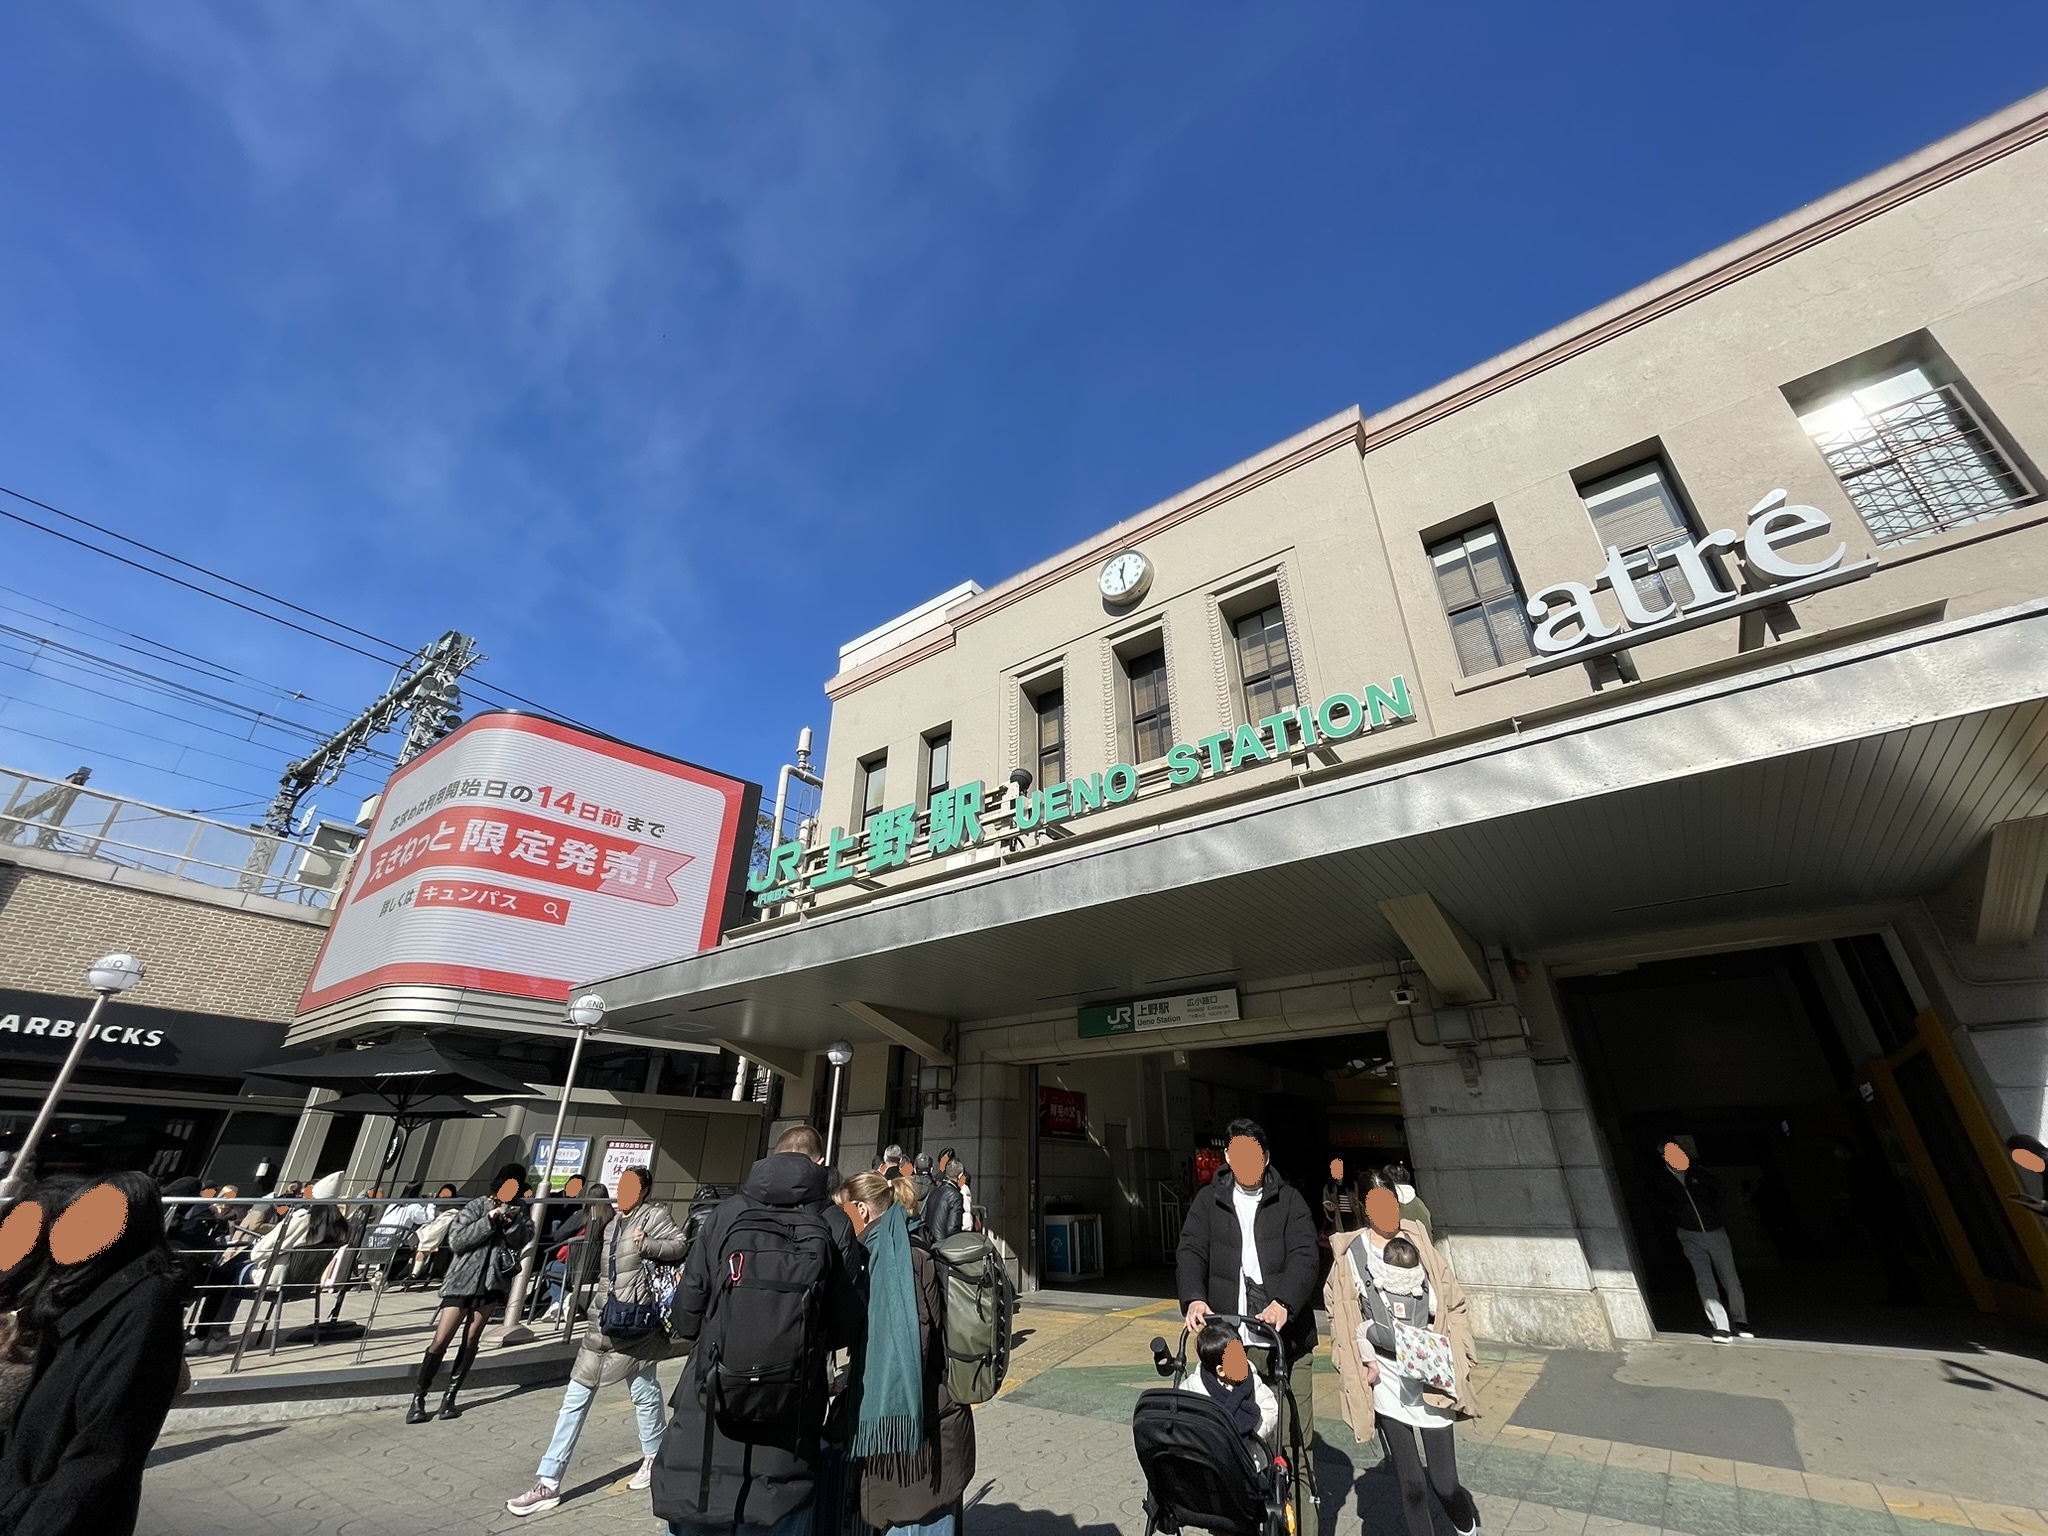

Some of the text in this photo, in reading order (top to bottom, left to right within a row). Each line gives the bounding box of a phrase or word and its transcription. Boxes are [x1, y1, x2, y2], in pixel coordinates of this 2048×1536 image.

[1526, 487, 1846, 655] atré
[1015, 763, 1138, 830] UENO
[1167, 674, 1415, 785] STATION
[422, 886, 518, 911] キュンパス
[1107, 1006, 1132, 1025] JR
[1137, 1002, 1170, 1017] 上野駅
[1137, 1018, 1155, 1027] Ueno
[1156, 1015, 1182, 1024] Station
